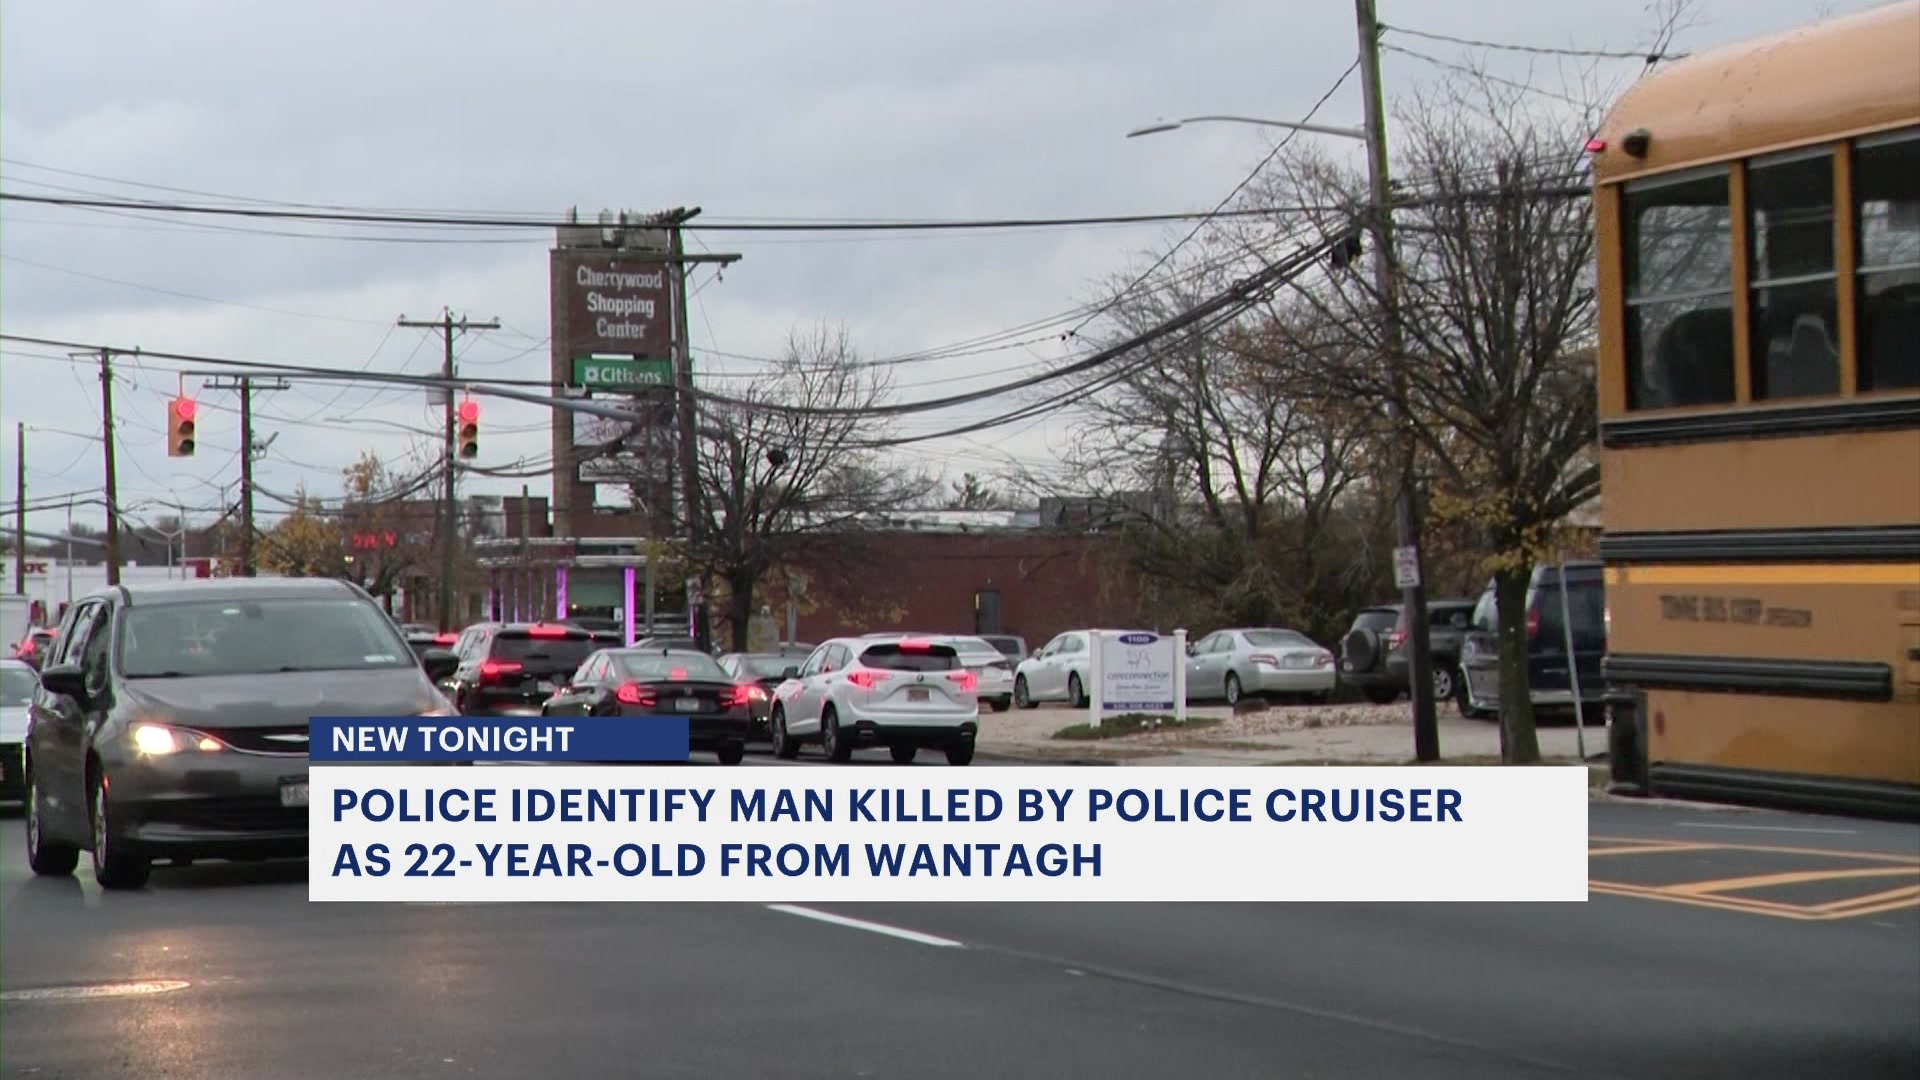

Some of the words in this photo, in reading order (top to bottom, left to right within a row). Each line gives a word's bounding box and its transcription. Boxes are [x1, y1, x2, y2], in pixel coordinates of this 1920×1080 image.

[577, 266, 663, 290] Cherrywood
[587, 292, 655, 318] Shopping
[596, 317, 647, 338] Center
